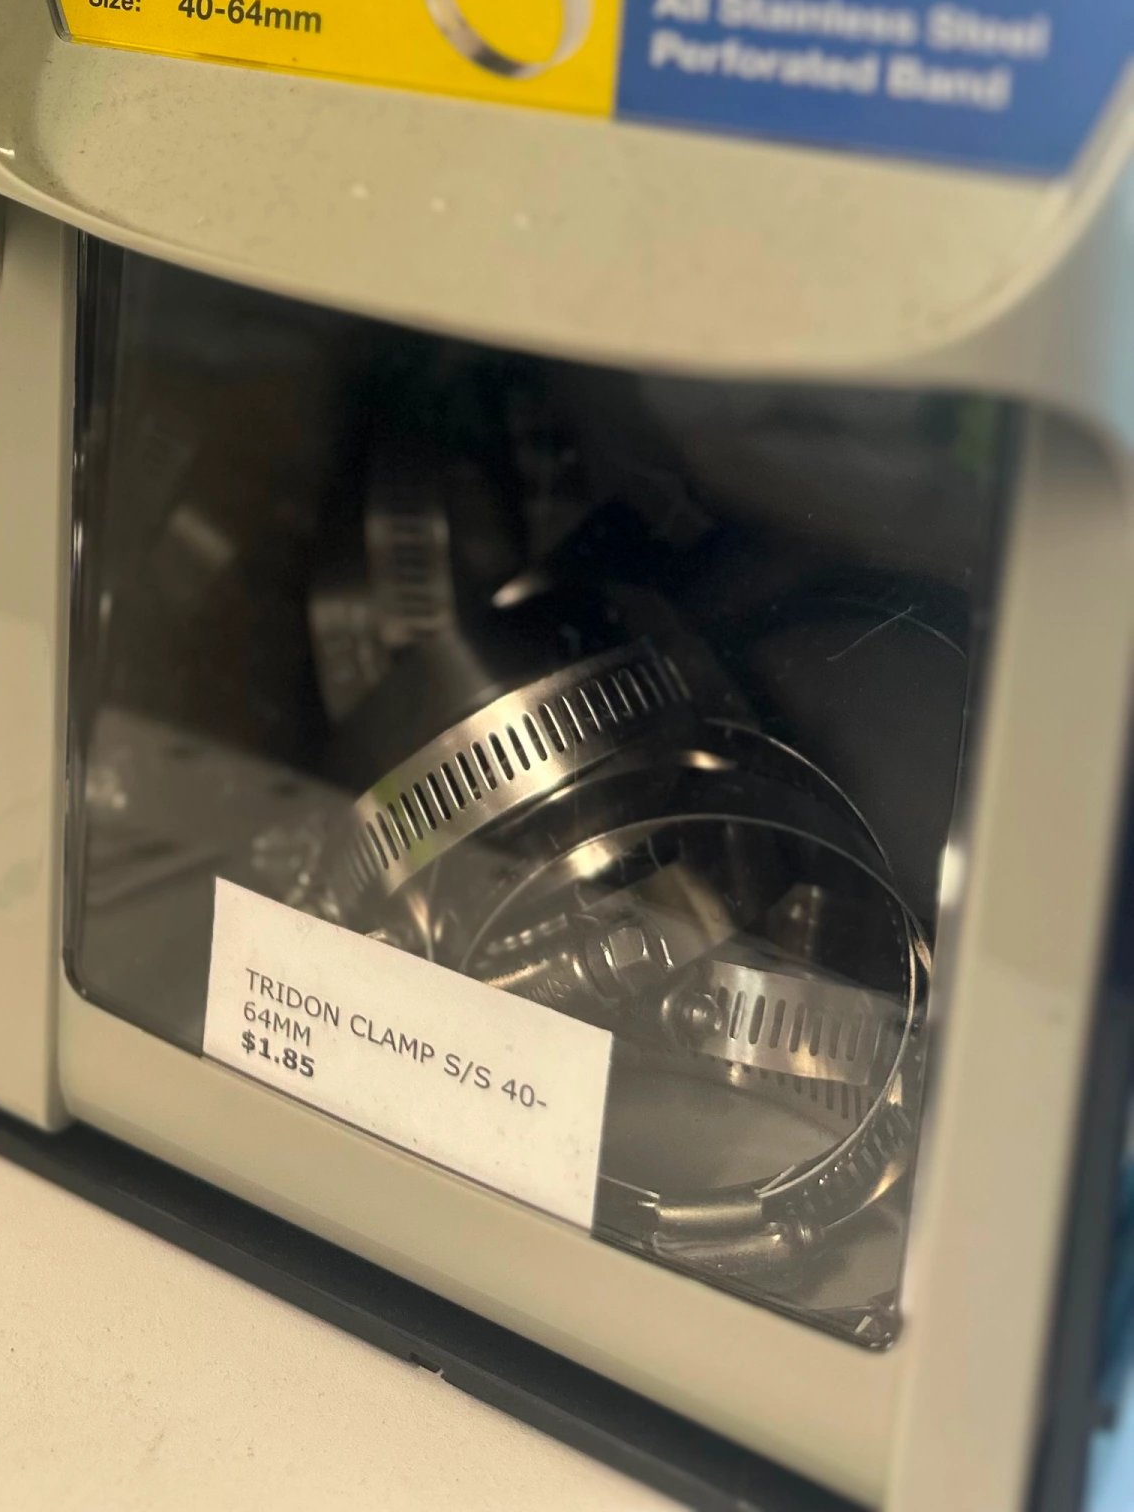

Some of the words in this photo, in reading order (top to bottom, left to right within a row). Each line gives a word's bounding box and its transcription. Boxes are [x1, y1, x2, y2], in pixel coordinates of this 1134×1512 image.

[243, 1000, 311, 1047] 64MM
[245, 968, 341, 1027] TRIDON
[350, 1013, 435, 1064] CLAMP
[444, 1053, 493, 1090] S/S
[500, 1079, 548, 1108] 40-
[241, 1029, 316, 1078] $1.85
